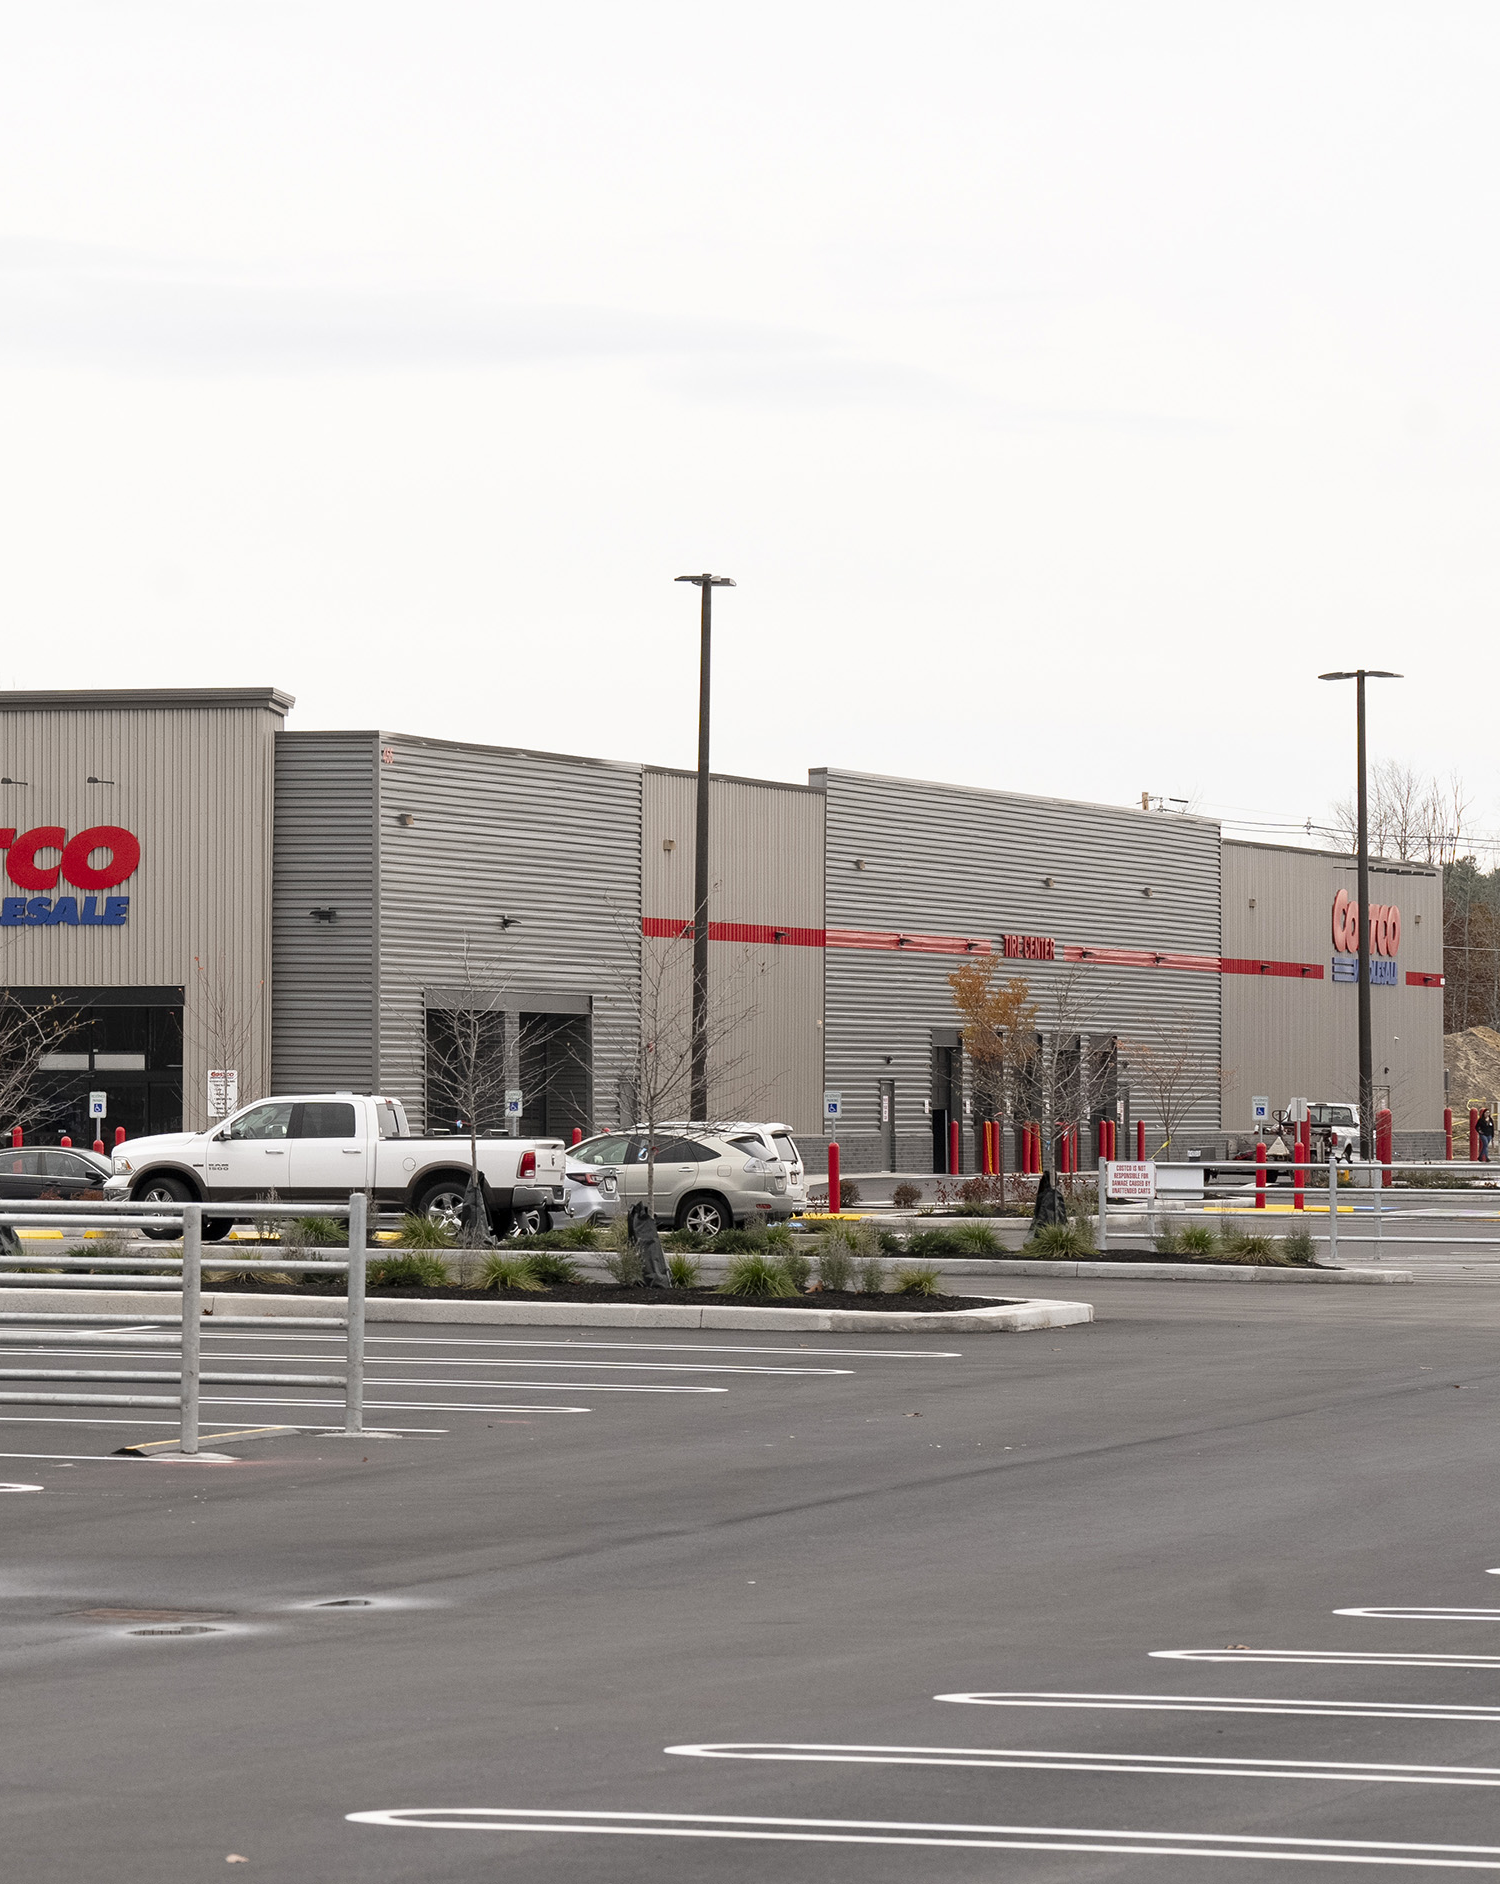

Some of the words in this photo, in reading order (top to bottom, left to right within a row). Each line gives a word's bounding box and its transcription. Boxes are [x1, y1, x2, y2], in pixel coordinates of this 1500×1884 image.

[1332, 888, 1401, 957] COTCO
[1004, 934, 1024, 958] TIRE
[1024, 936, 1056, 960] CENTER
